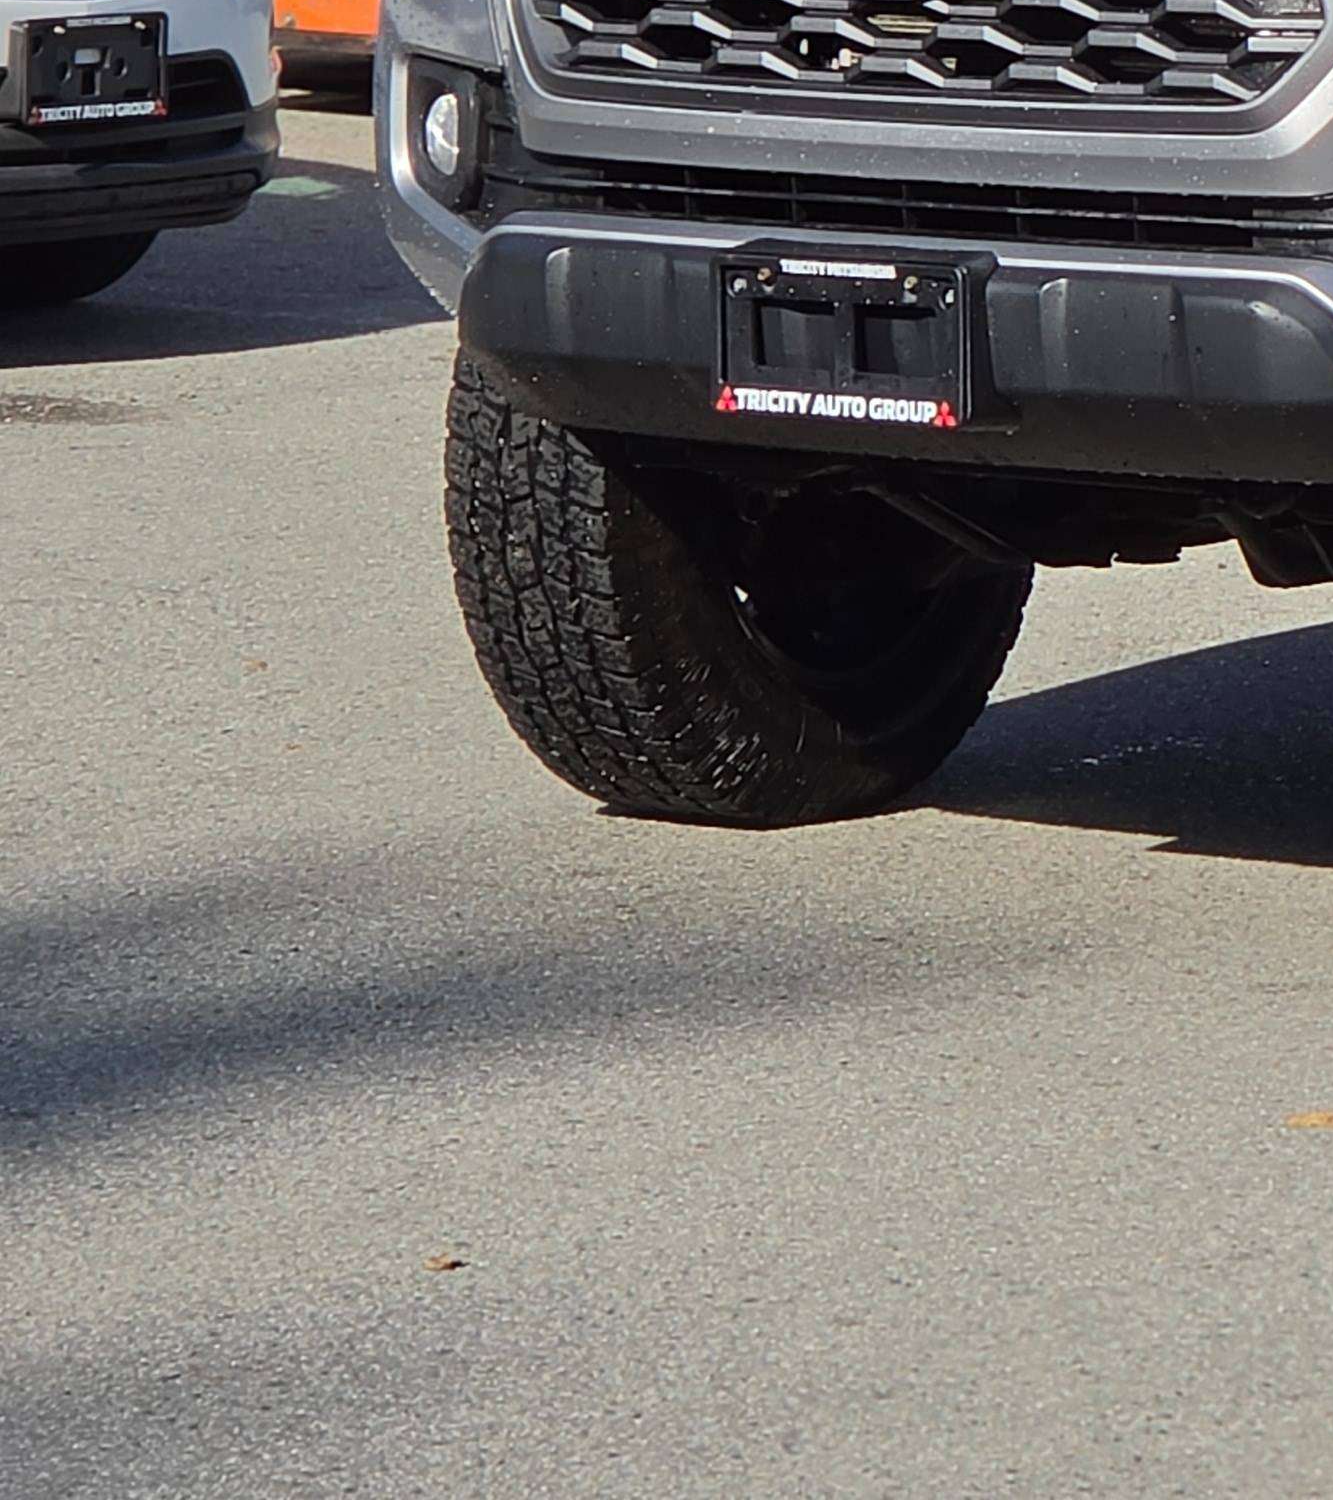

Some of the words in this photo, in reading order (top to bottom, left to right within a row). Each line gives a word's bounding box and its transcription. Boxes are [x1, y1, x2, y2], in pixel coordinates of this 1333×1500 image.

[733, 387, 812, 415] TRICITY
[811, 393, 867, 419] AUTO
[868, 397, 938, 424] GROUP
